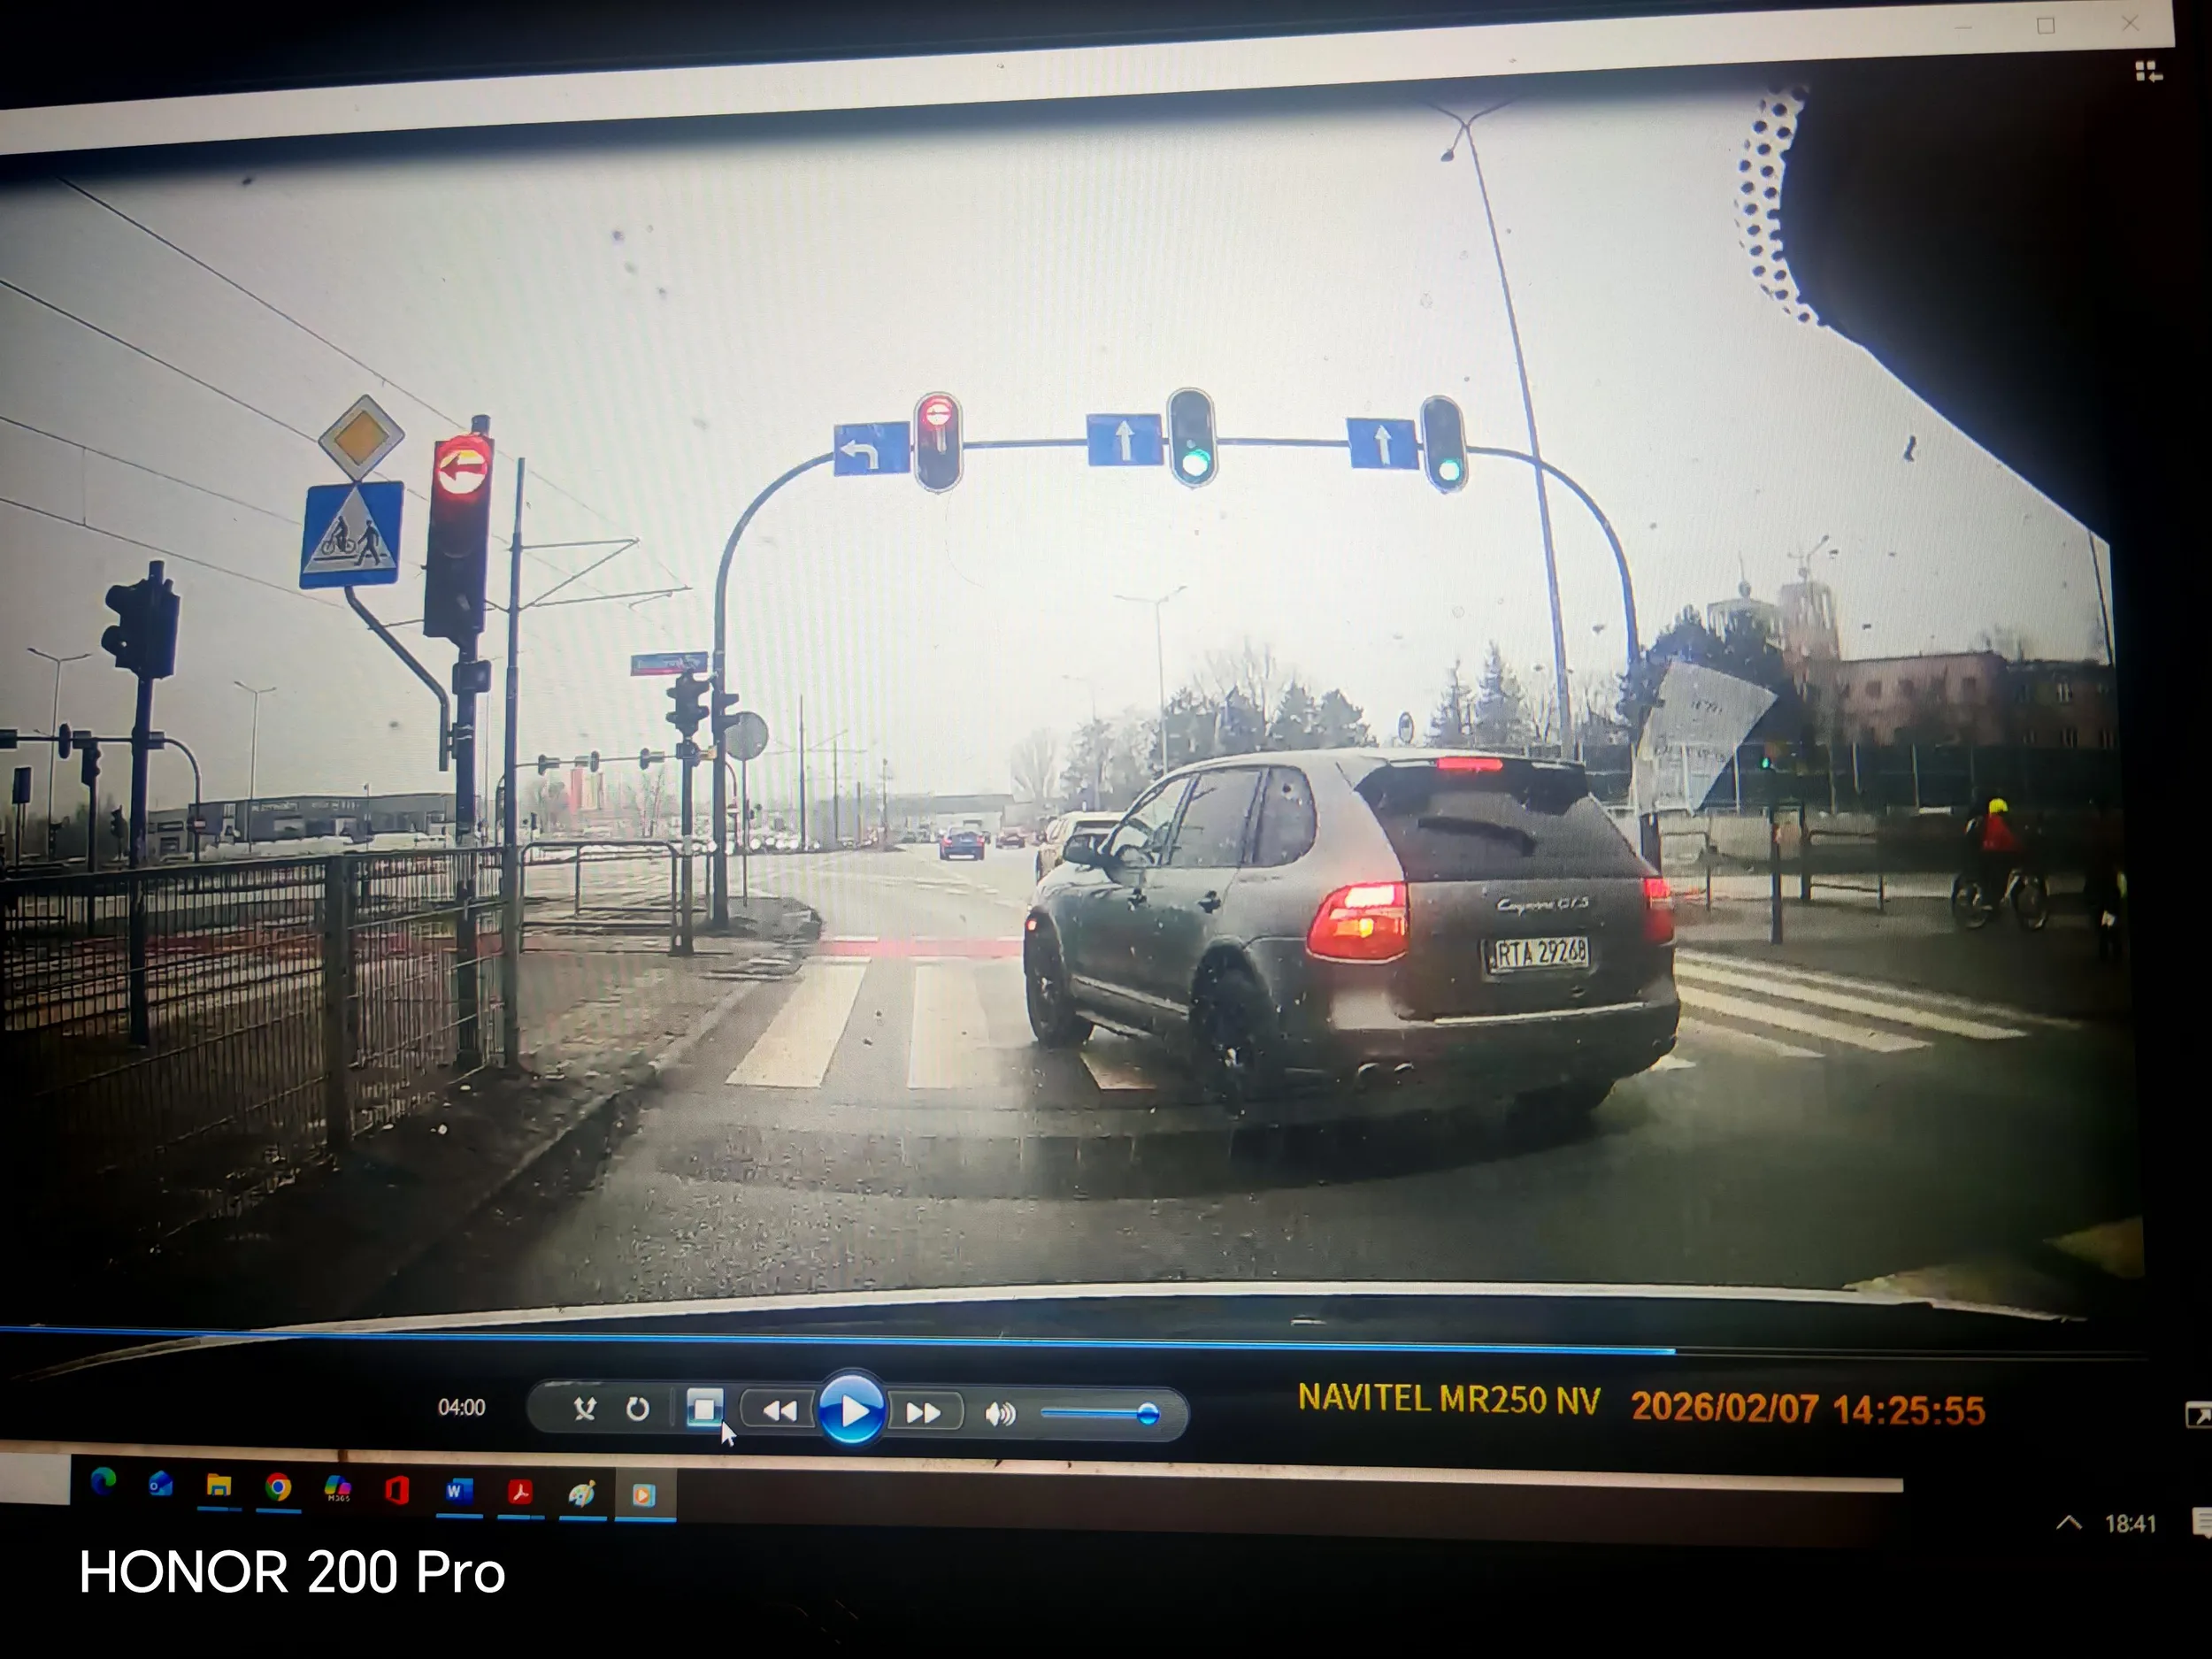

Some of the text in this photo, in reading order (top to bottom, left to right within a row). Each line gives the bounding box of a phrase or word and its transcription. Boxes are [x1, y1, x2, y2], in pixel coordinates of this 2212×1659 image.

[1498, 941, 1532, 965] RTA
[438, 1398, 486, 1417] 04:00
[1298, 1382, 1601, 1415] NAVITEL MR250 NV
[1631, 1390, 1985, 1425] 2026/02/07 14:25:55
[448, 1485, 461, 1498] W
[2106, 1514, 2155, 1533] 18:41
